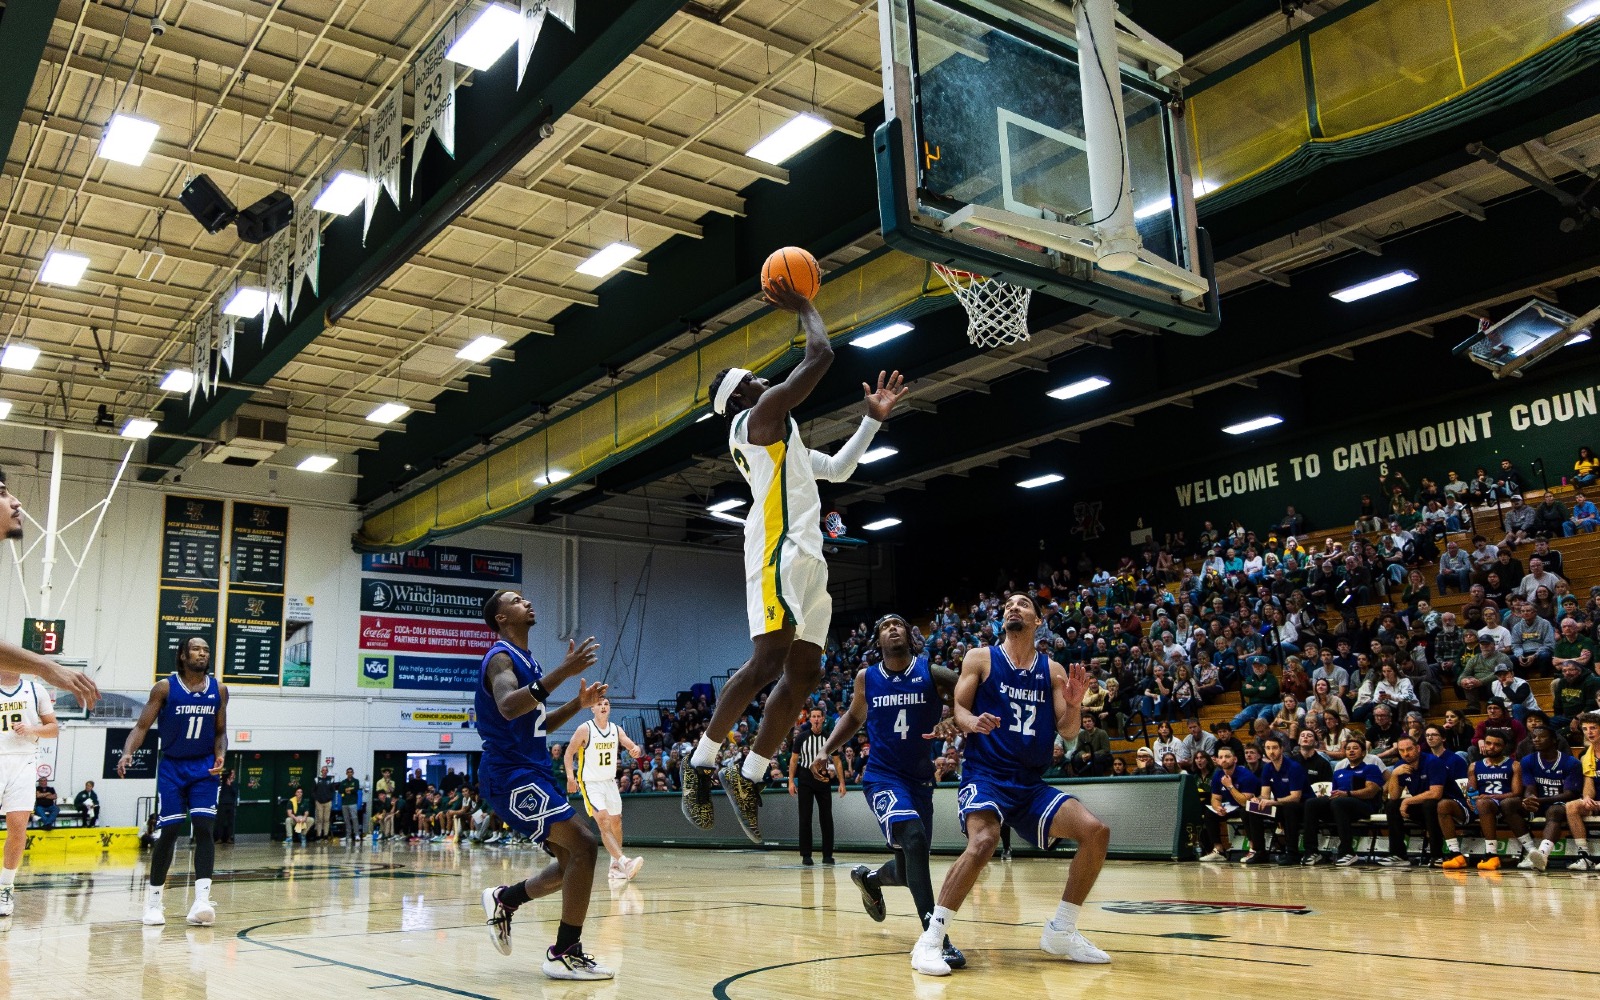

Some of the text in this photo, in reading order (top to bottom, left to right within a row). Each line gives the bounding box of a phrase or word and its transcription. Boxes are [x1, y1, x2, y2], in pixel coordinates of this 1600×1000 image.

[424, 36, 446, 66] KEVIN
[424, 73, 442, 111] 33
[415, 92, 452, 139] 988-1992
[378, 136, 390, 167] 10
[1175, 385, 1600, 508] WELCOME TO CATAMOUNT COUN
[1379, 462, 1389, 476] 6
[393, 585, 483, 607] Windjammer
[415, 606, 441, 614] UPPER
[443, 607, 464, 616] DECK
[467, 609, 483, 617] PUB
[35, 621, 55, 632] 4.1
[394, 625, 427, 635] COCA-COLA
[428, 627, 459, 637] BEVERAGES
[459, 630, 490, 639] NORTHEAST
[44, 632, 57, 651] 3
[394, 635, 419, 644] PARTNER
[419, 636, 427, 645] OF
[428, 637, 459, 646] UNIVERSITY
[459, 639, 467, 647] OF
[366, 664, 387, 674] VSAC
[409, 665, 424, 673] help
[417, 674, 433, 682] plan
[1000, 681, 1046, 703] STONEHILL
[0, 701, 27, 712] ERMONT
[872, 692, 927, 708] STONEHILL
[893, 709, 910, 740] 4
[1009, 701, 1037, 736] 32
[186, 716, 203, 739] 11
[595, 742, 616, 750] VERMONT
[599, 752, 611, 766] 12
[1484, 781, 1503, 794] 22
